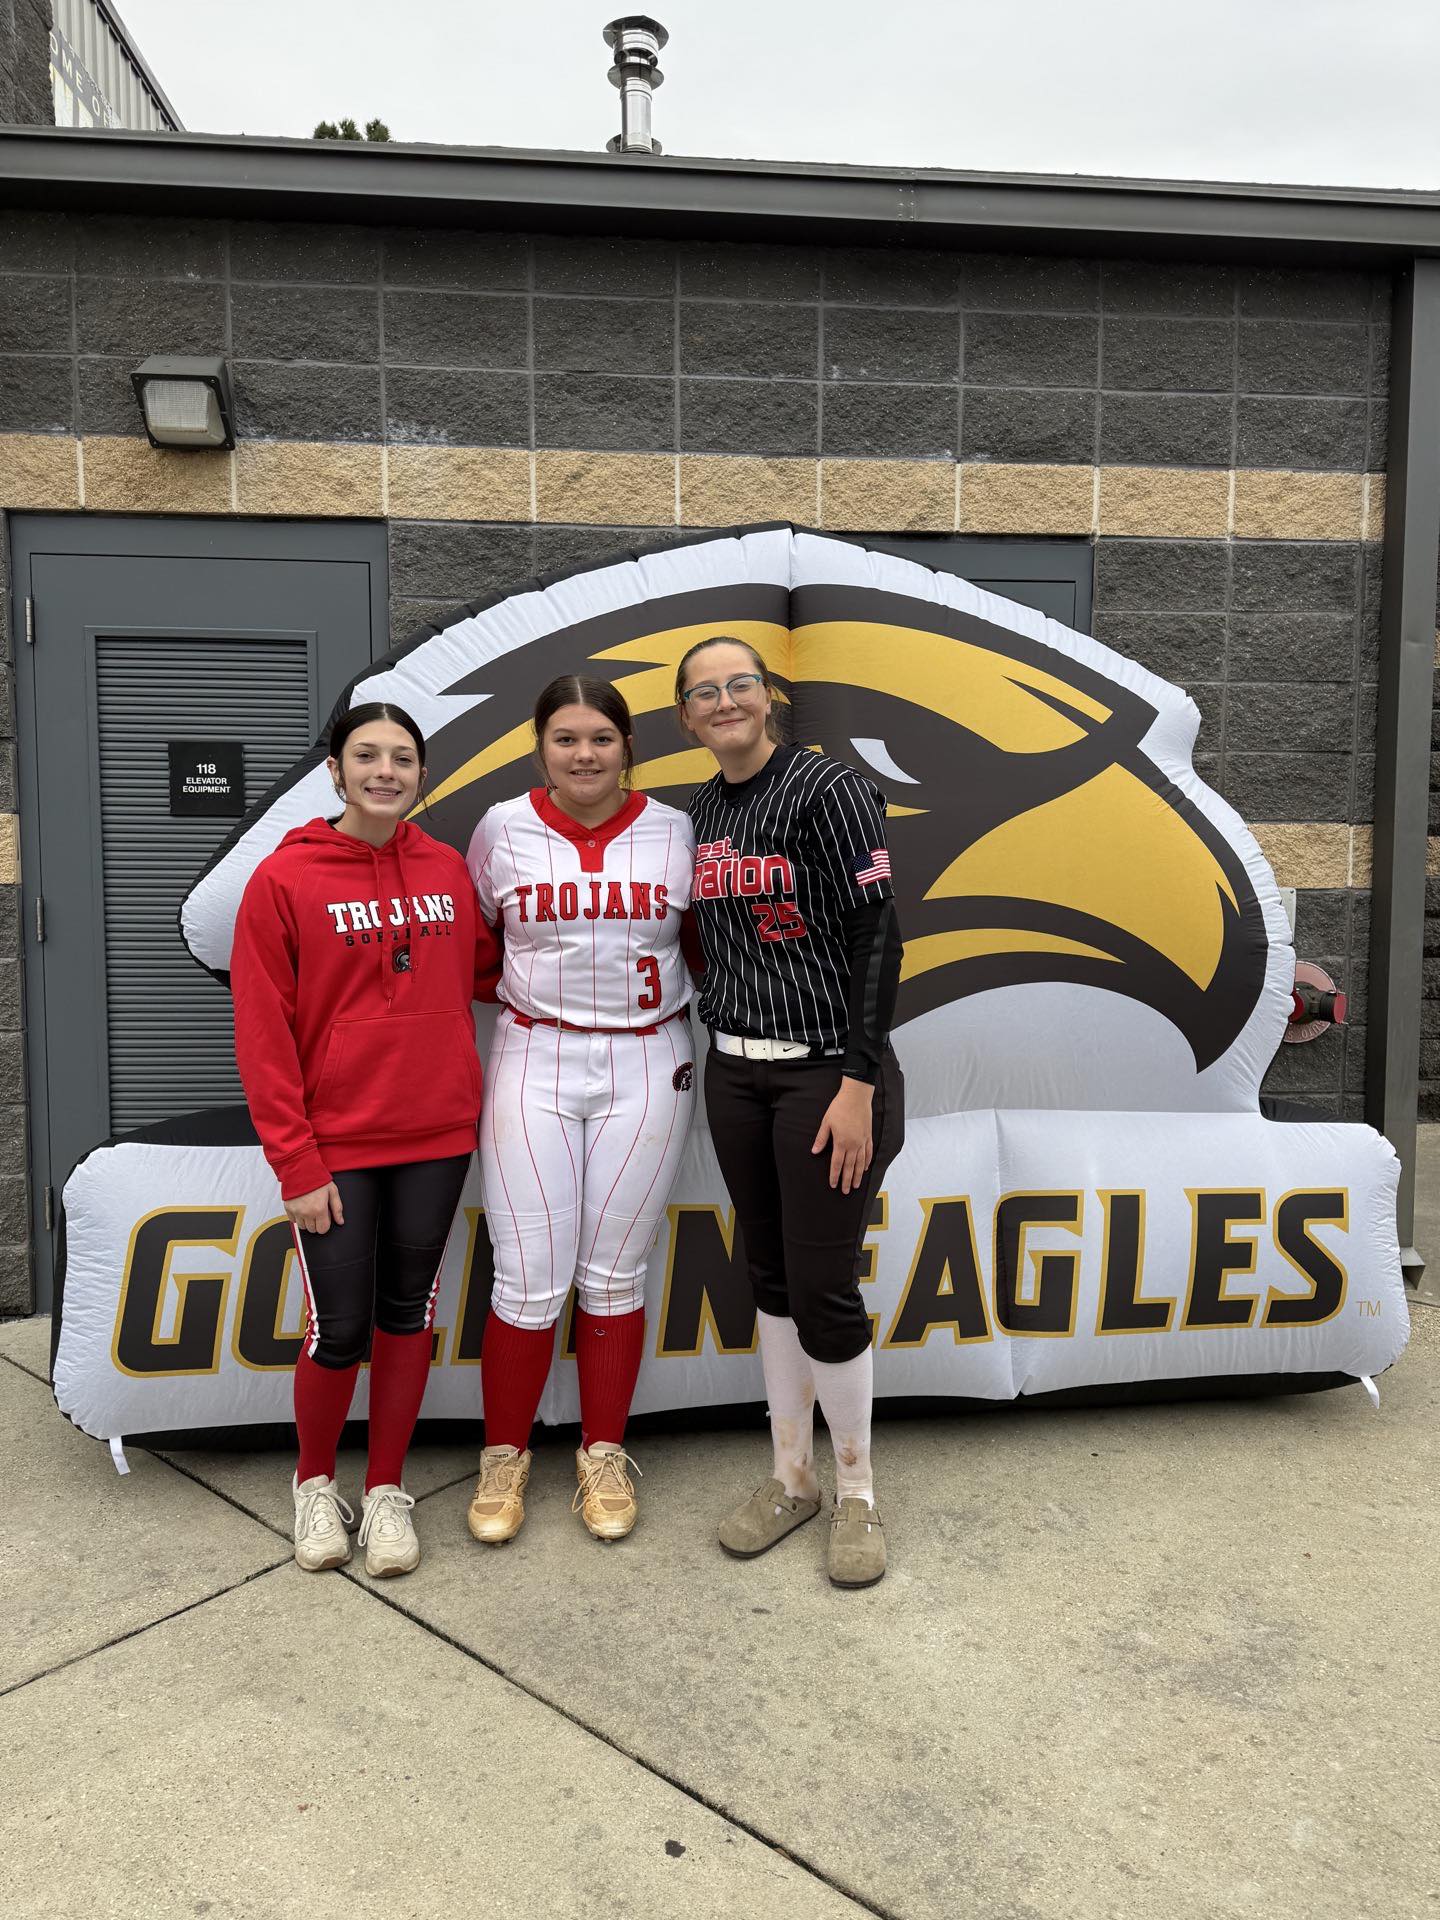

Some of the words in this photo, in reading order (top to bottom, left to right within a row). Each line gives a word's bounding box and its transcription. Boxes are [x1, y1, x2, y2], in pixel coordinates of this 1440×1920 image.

[49, 31, 83, 93] OME
[186, 777, 228, 785] ELEVATOR
[196, 763, 217, 775] 118
[182, 785, 232, 794] EQUIPMENT
[696, 836, 732, 862] est
[327, 893, 455, 934] TROJANS
[515, 881, 669, 923] TROJANS
[751, 901, 808, 942] 25
[636, 955, 662, 1010] 3
[1355, 1300, 1381, 1316] TM
